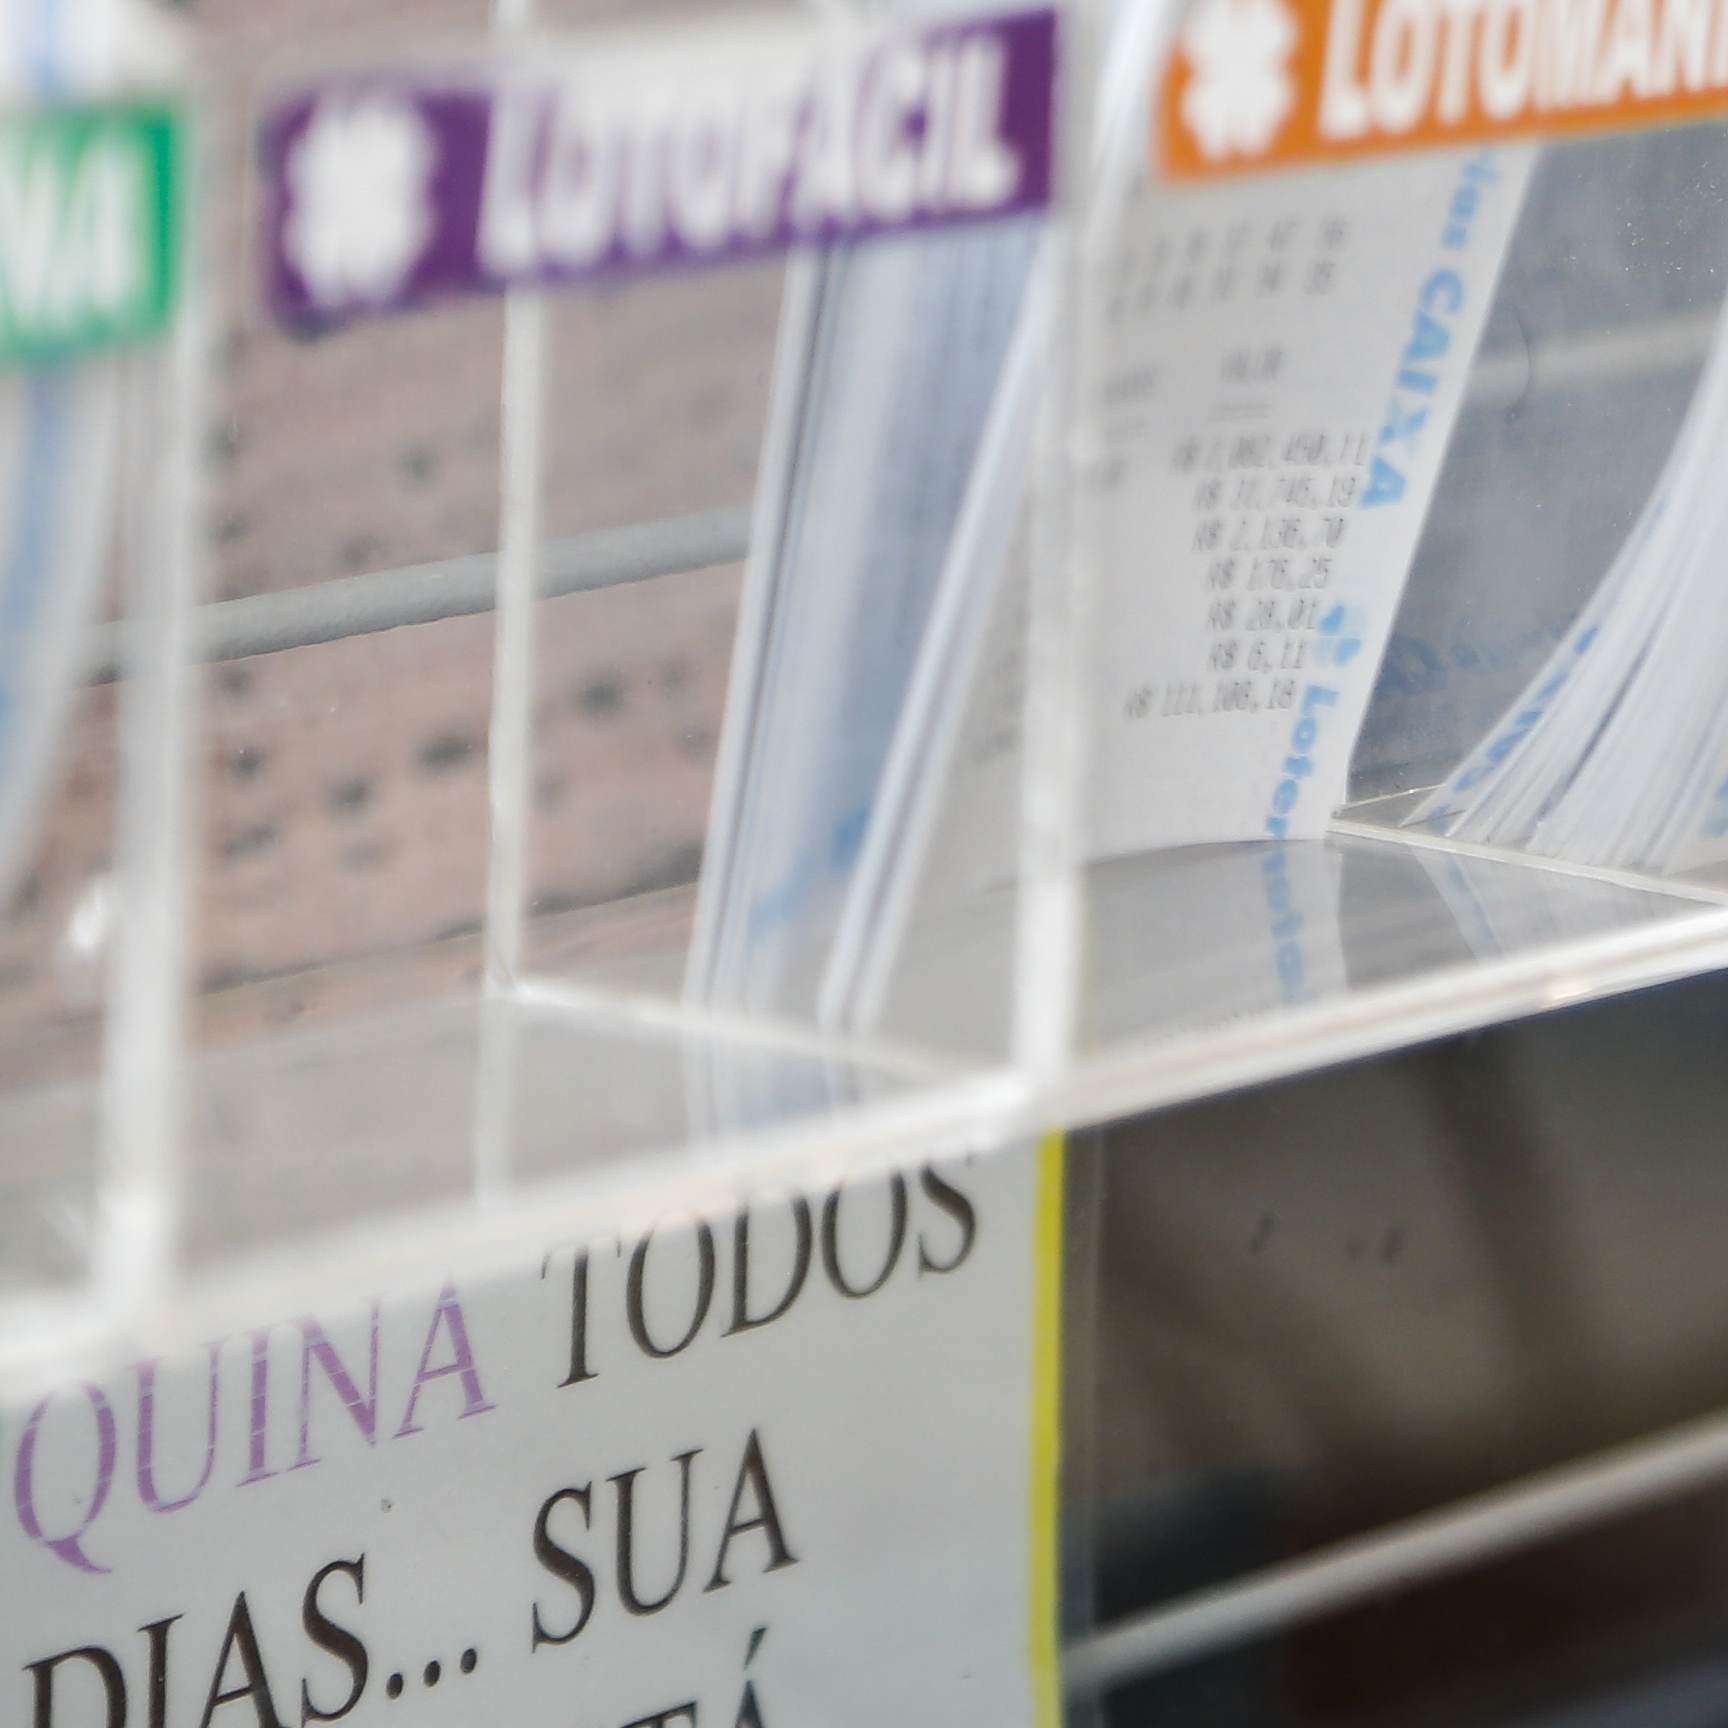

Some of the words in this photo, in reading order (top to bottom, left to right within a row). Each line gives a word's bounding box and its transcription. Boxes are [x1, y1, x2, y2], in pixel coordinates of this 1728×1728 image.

[1359, 267, 1466, 510] CAIXA
[13, 1277, 496, 1574] QUINA
[541, 1158, 979, 1390] TODOS
[530, 1428, 800, 1654] SUA
